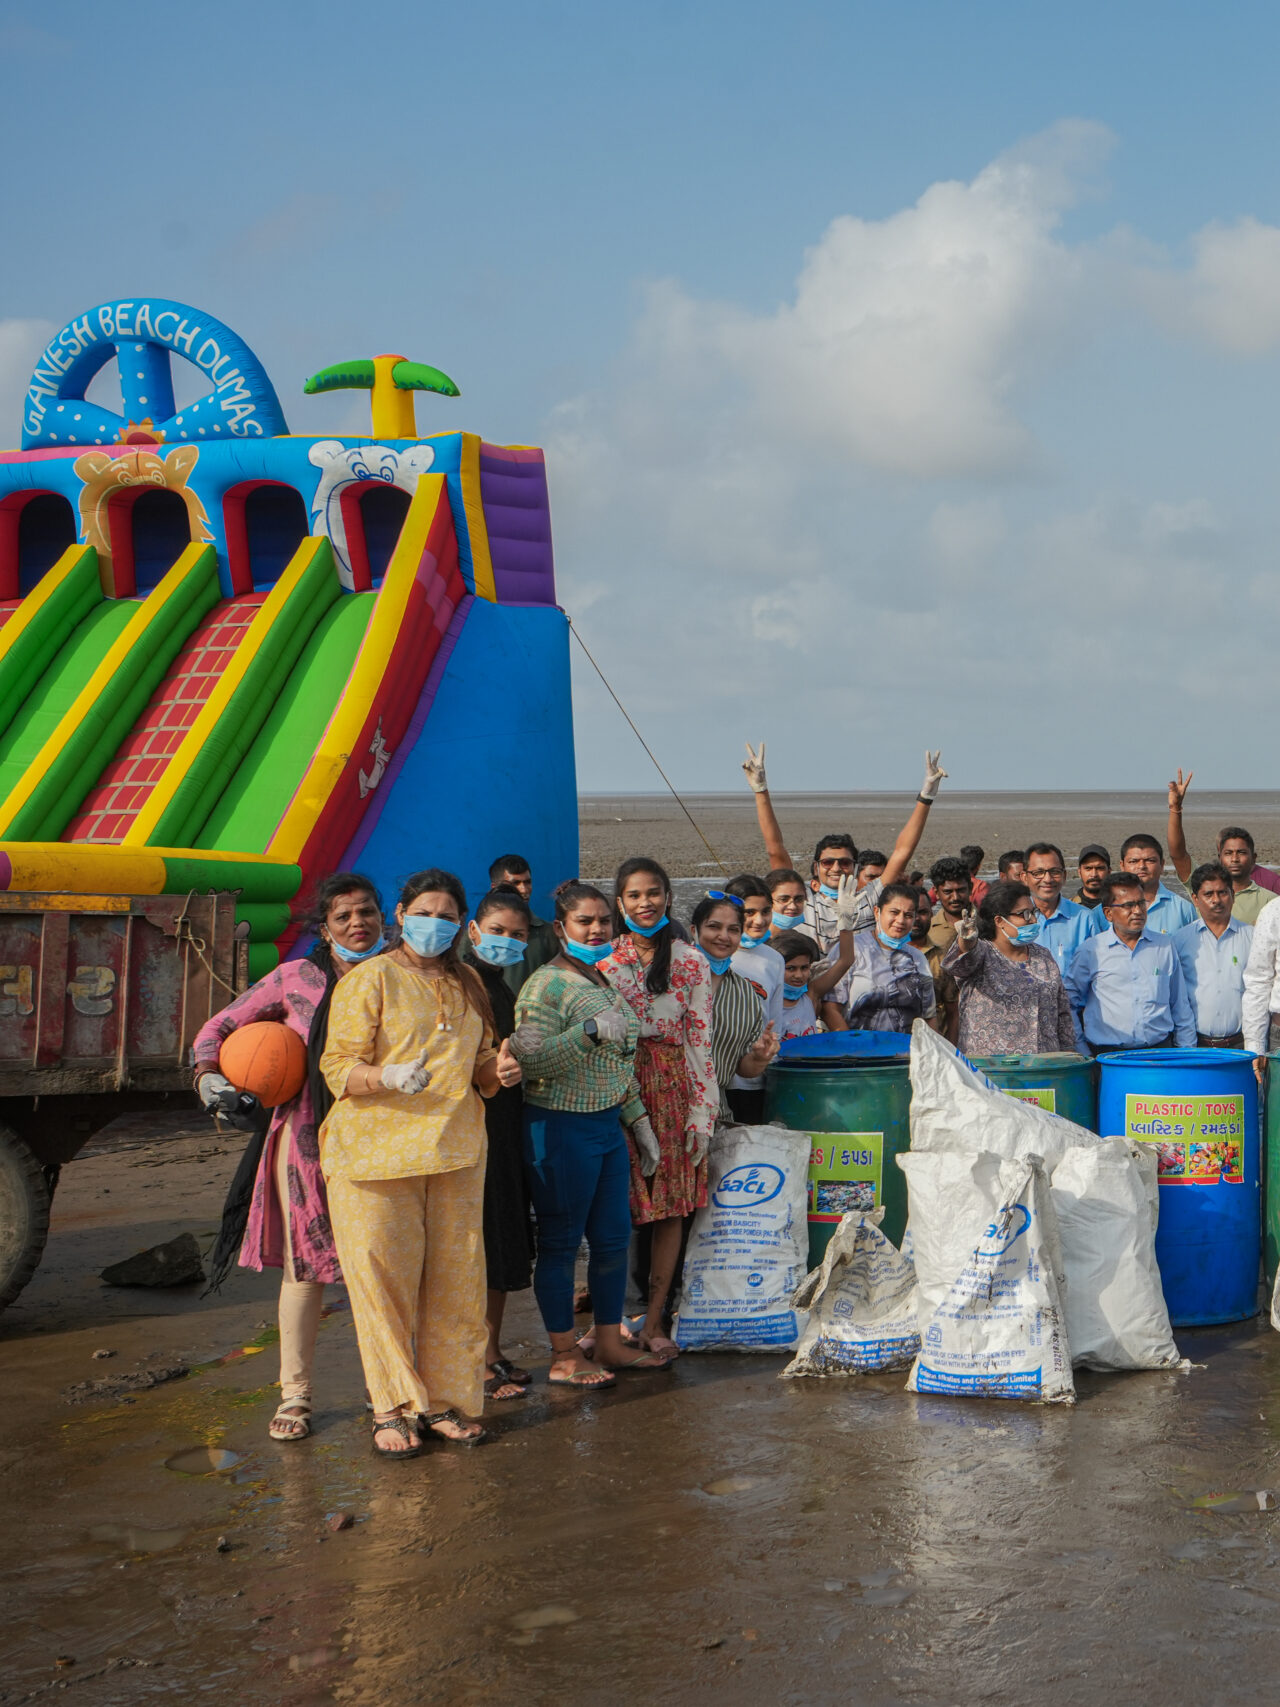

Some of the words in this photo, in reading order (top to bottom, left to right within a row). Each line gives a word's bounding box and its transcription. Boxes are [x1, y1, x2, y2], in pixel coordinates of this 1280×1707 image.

[23, 315, 98, 436] GANESH
[98, 303, 202, 353] BEACH
[195, 338, 263, 438] DUMAS
[1135, 1103, 1193, 1116] PLASTIC
[1205, 1102, 1236, 1116] TOYS
[1131, 1119, 1185, 1135] પ્લાસ્ટિક
[733, 1319, 766, 1328] Chemicals
[768, 1316, 792, 1325] Limited
[1010, 1374, 1037, 1383] Limited
